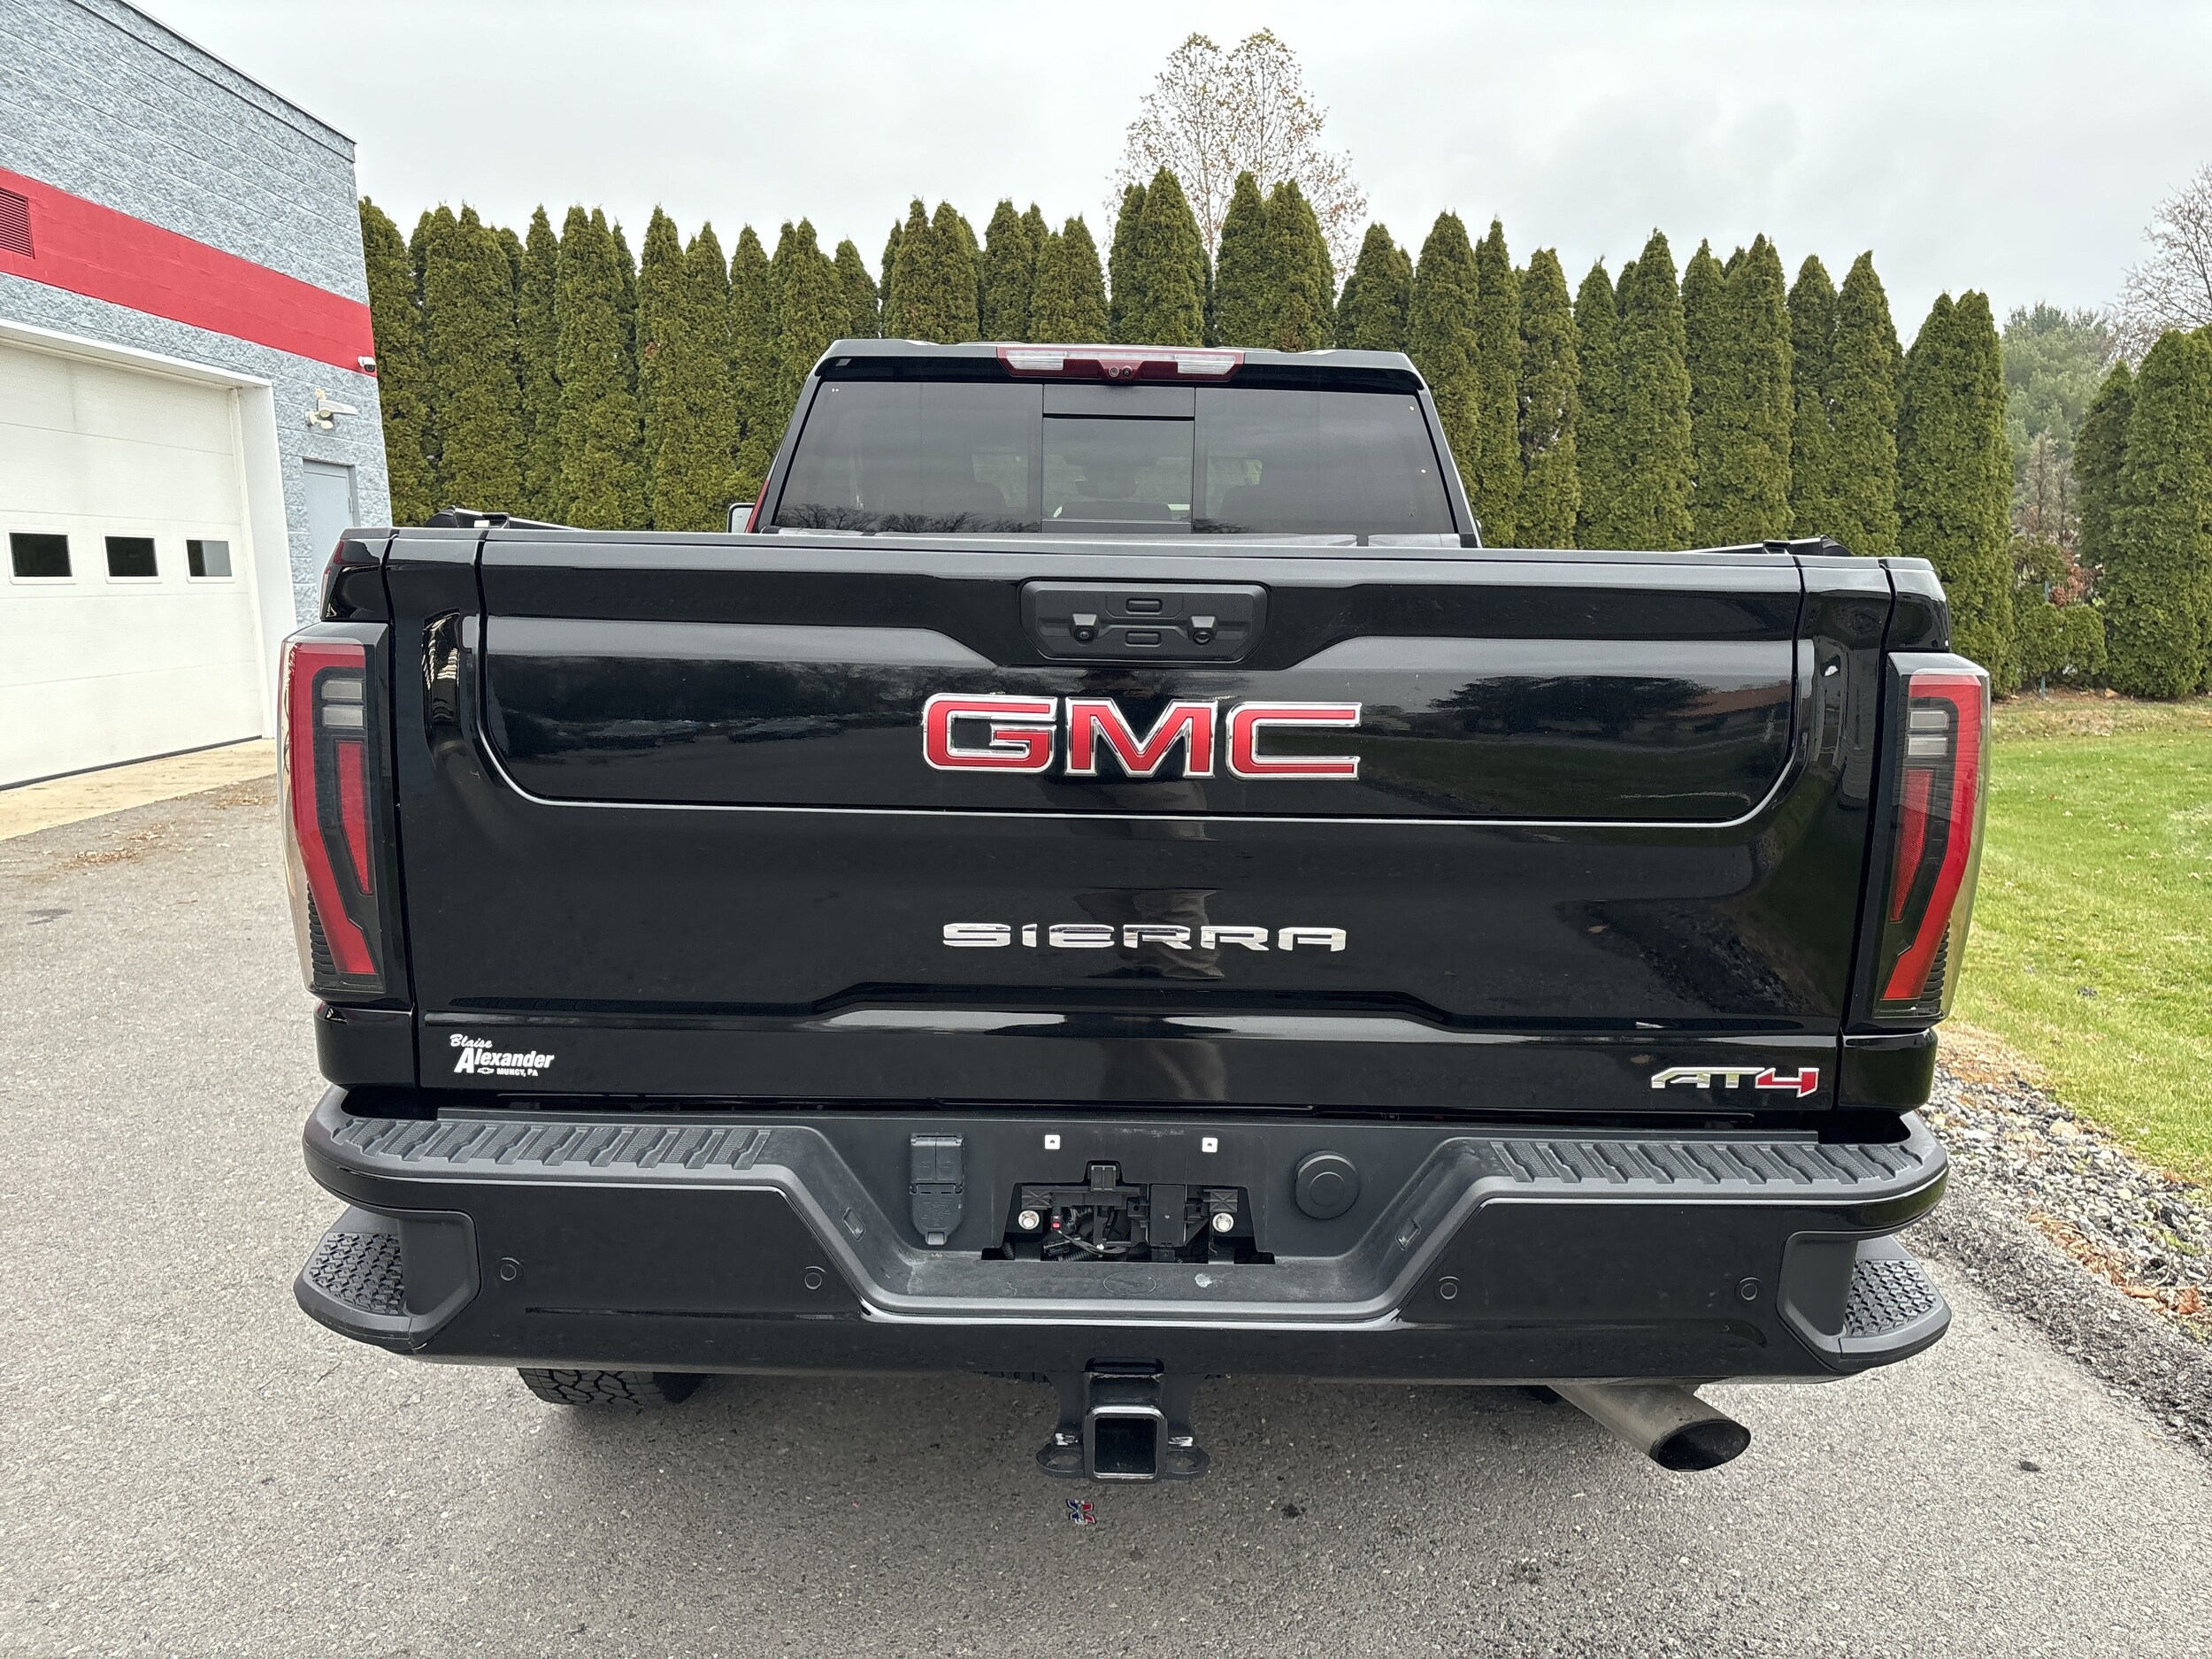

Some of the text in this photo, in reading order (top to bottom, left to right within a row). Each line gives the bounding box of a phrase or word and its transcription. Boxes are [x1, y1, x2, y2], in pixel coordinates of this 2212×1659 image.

[921, 693, 1363, 780] GMC
[942, 923, 1347, 951] SIERRA
[449, 1033, 493, 1048] Blaise
[453, 1047, 556, 1073] Alexander
[496, 1067, 539, 1078] MUNCY, PA
[1651, 1067, 1819, 1098] AT4
